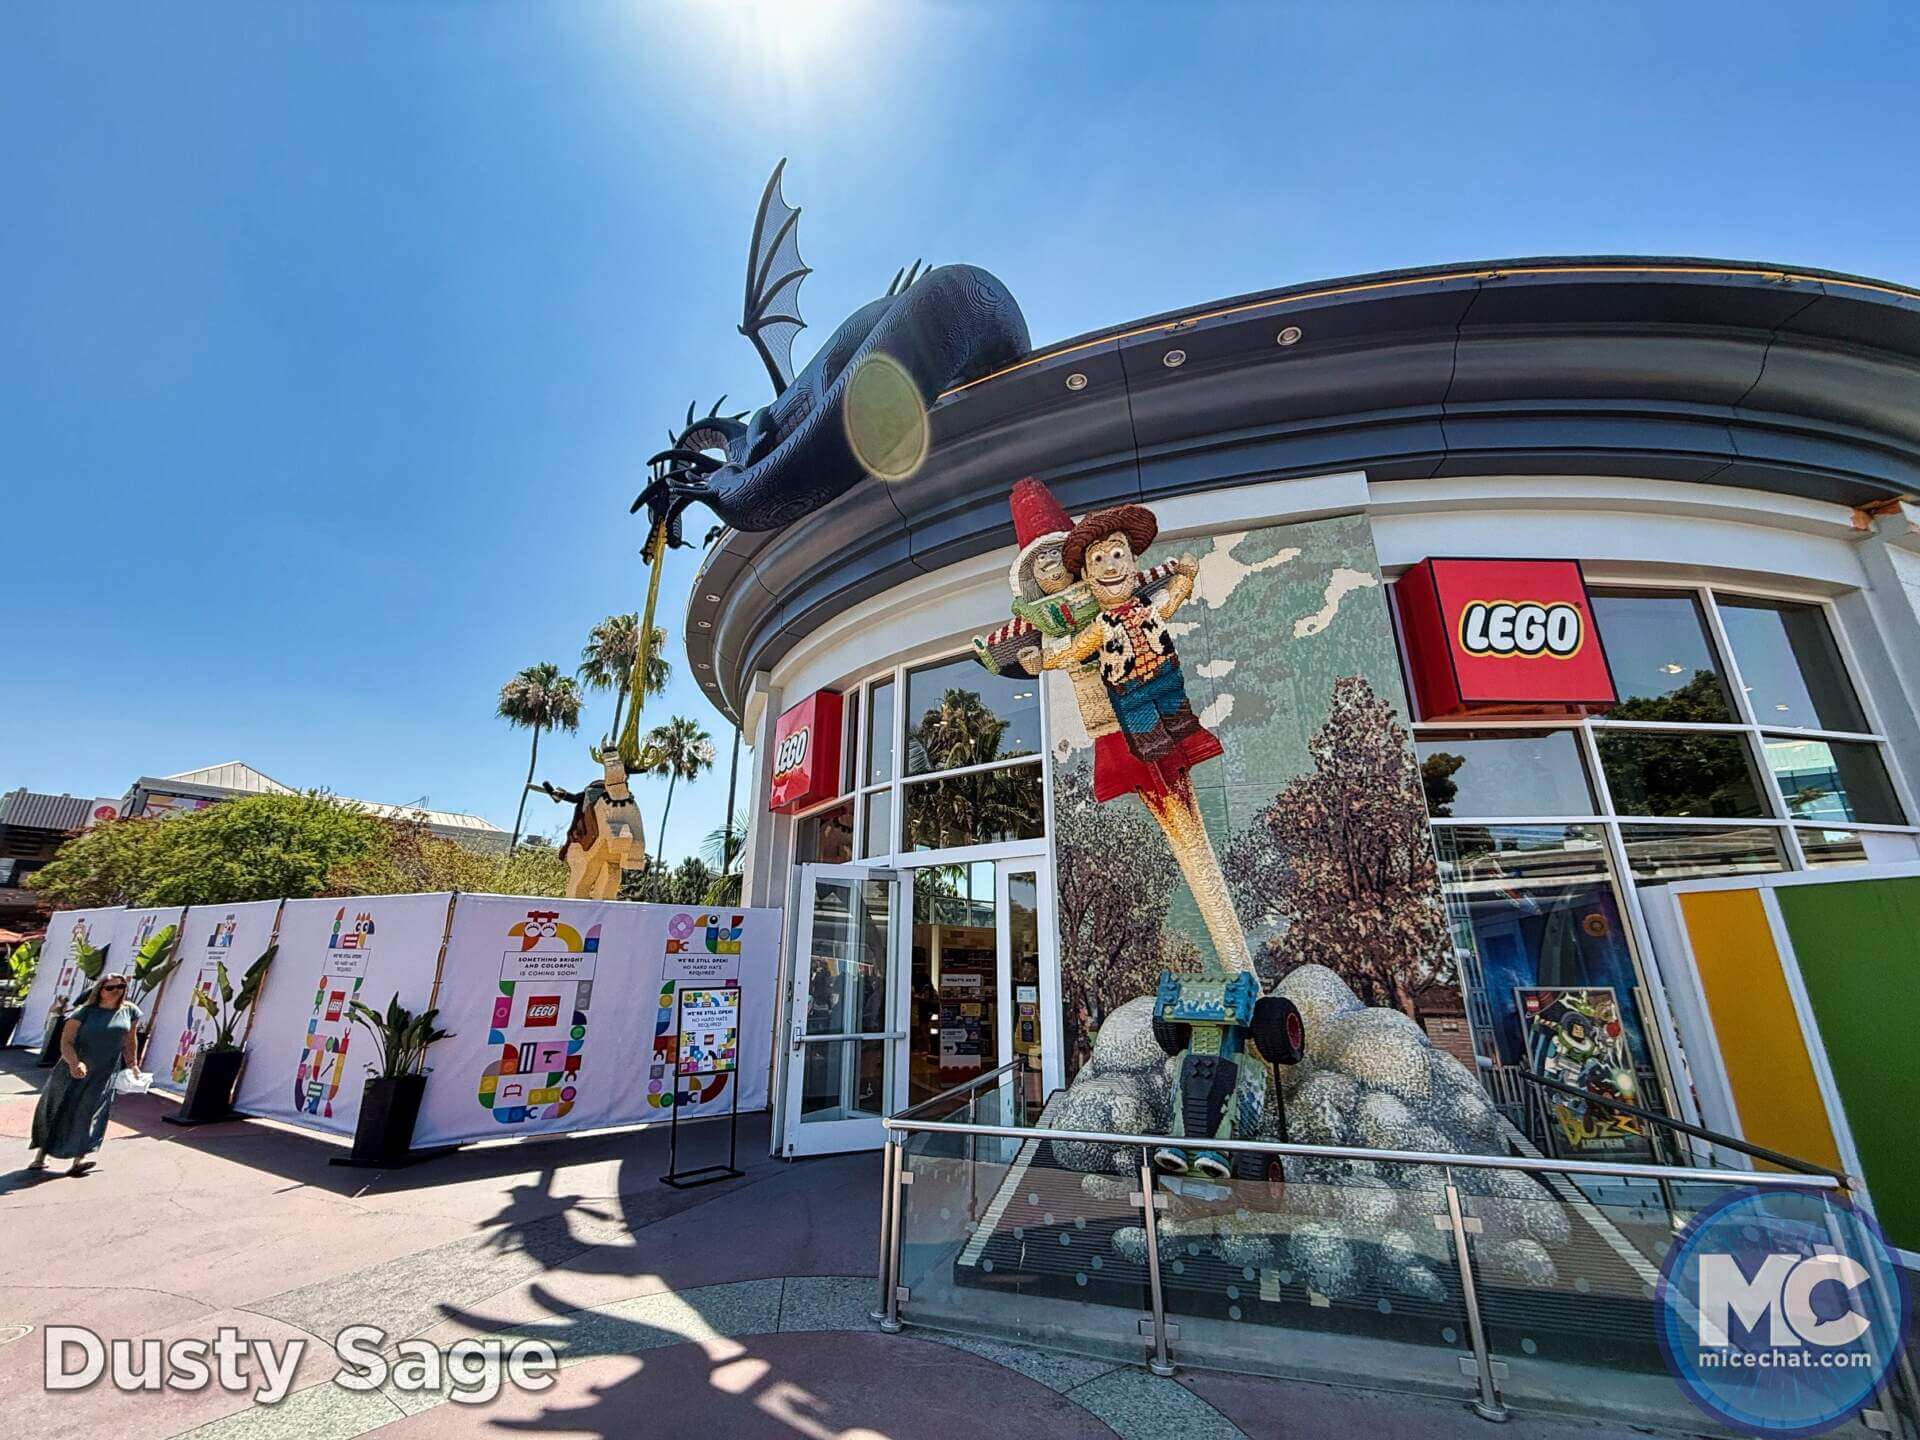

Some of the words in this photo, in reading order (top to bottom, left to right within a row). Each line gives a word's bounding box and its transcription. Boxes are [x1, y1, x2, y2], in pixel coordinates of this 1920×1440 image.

[1461, 602, 1580, 656] LEGO
[775, 729, 808, 777] LEGO
[528, 1005, 557, 1017] LEGO
